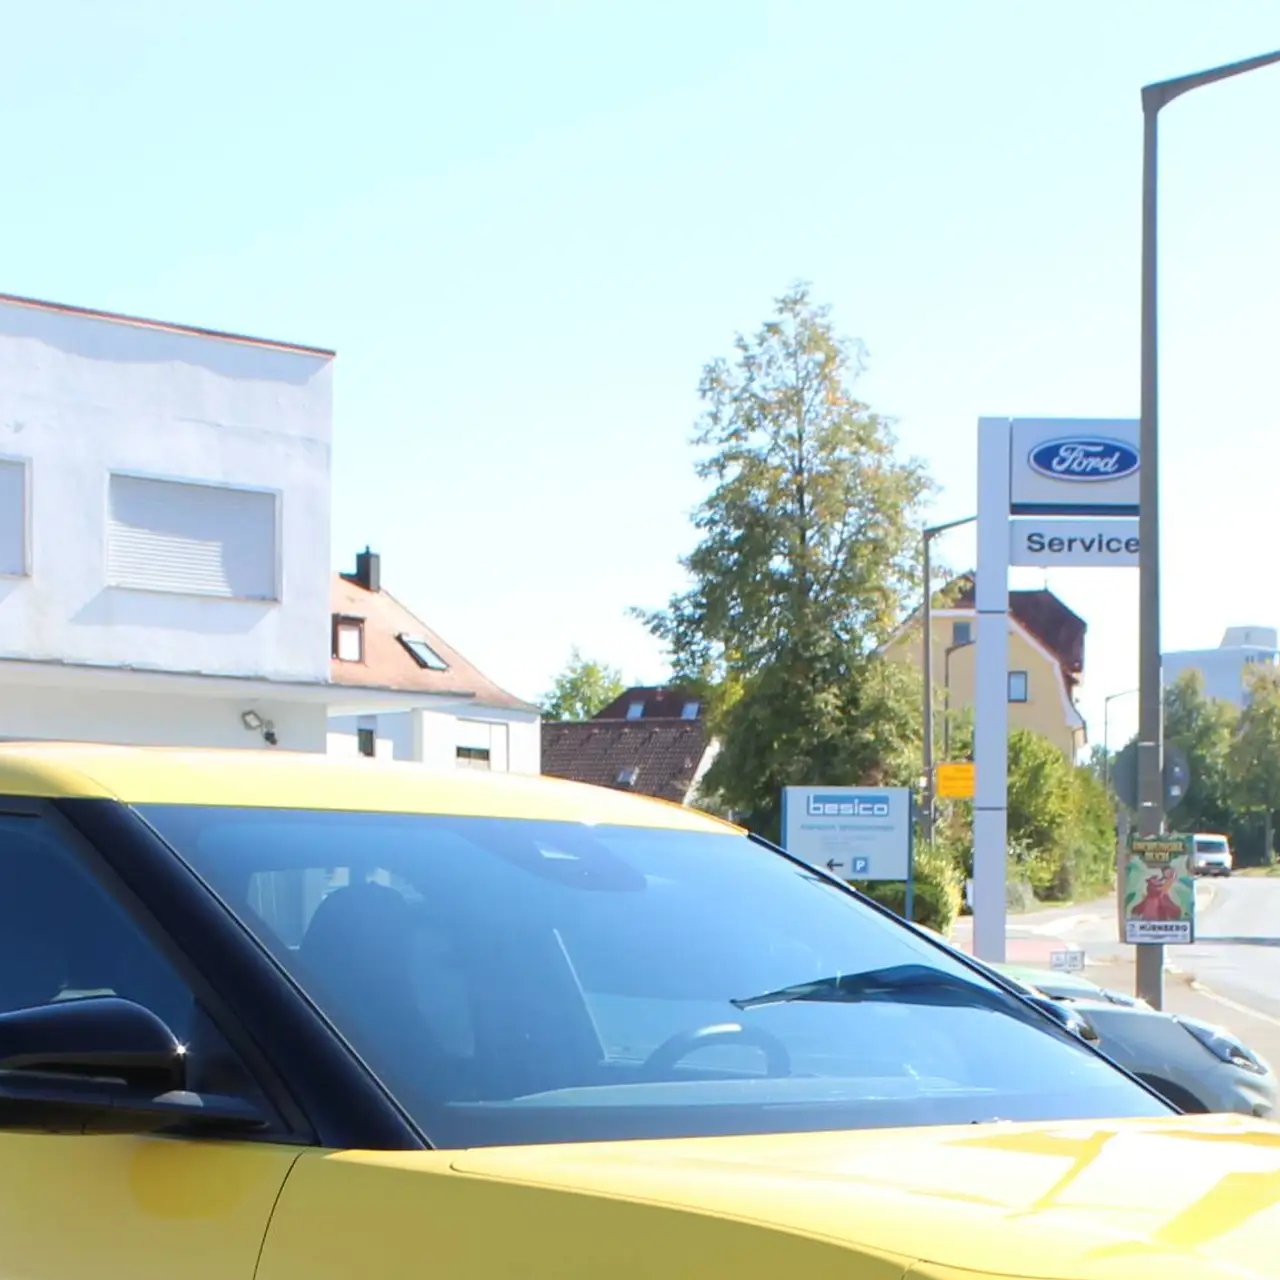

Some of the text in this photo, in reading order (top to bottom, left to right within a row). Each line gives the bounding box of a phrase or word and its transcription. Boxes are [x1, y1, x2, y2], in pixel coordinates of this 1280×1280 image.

[1051, 443, 1120, 474] Ford
[1026, 532, 1140, 555] Service
[808, 794, 889, 815] besico
[855, 860, 866, 872] P
